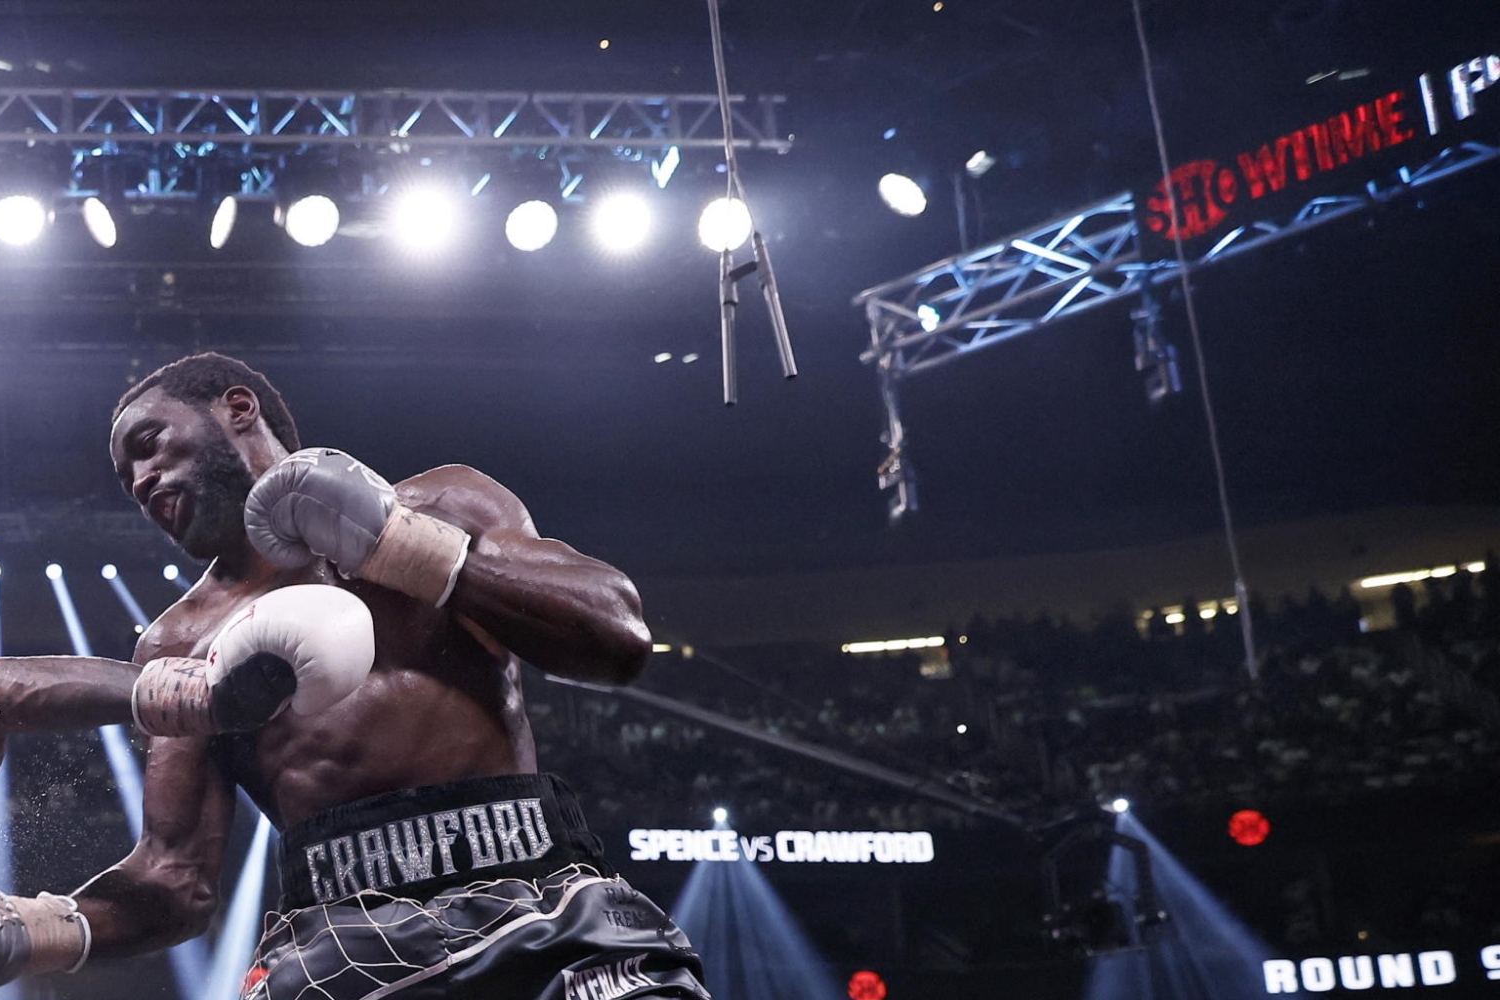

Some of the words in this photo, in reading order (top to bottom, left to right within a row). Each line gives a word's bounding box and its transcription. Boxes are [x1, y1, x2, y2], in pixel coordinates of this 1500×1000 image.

[1146, 92, 1414, 240] SHOWTIME
[304, 798, 554, 903] CRAWFORD
[628, 828, 740, 861] SPENCE
[775, 830, 935, 863] CRAWFORD
[1263, 950, 1456, 994] ROUND
